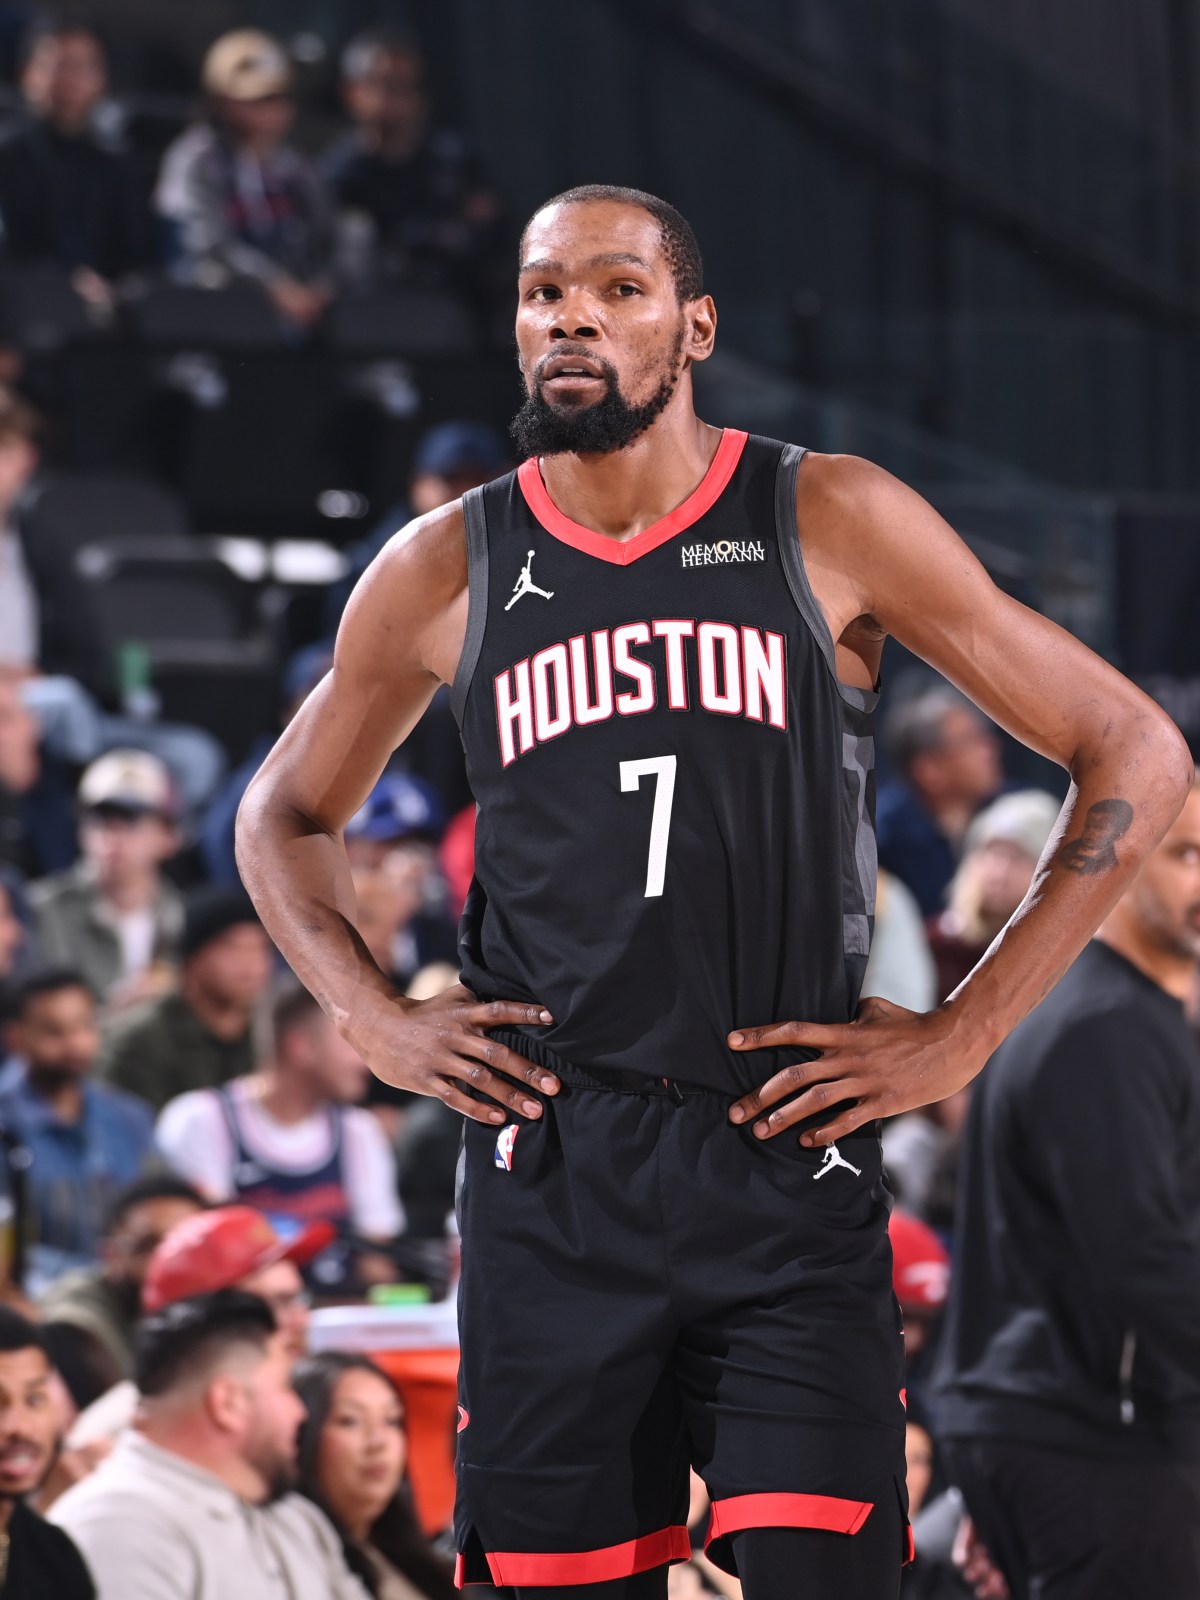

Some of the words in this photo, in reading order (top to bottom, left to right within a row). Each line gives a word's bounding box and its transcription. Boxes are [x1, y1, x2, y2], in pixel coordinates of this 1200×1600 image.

[681, 540, 765, 557] MEMORIAL
[681, 550, 765, 567] HERMANN
[494, 619, 788, 768] HOUSTON
[619, 755, 677, 898] 7
